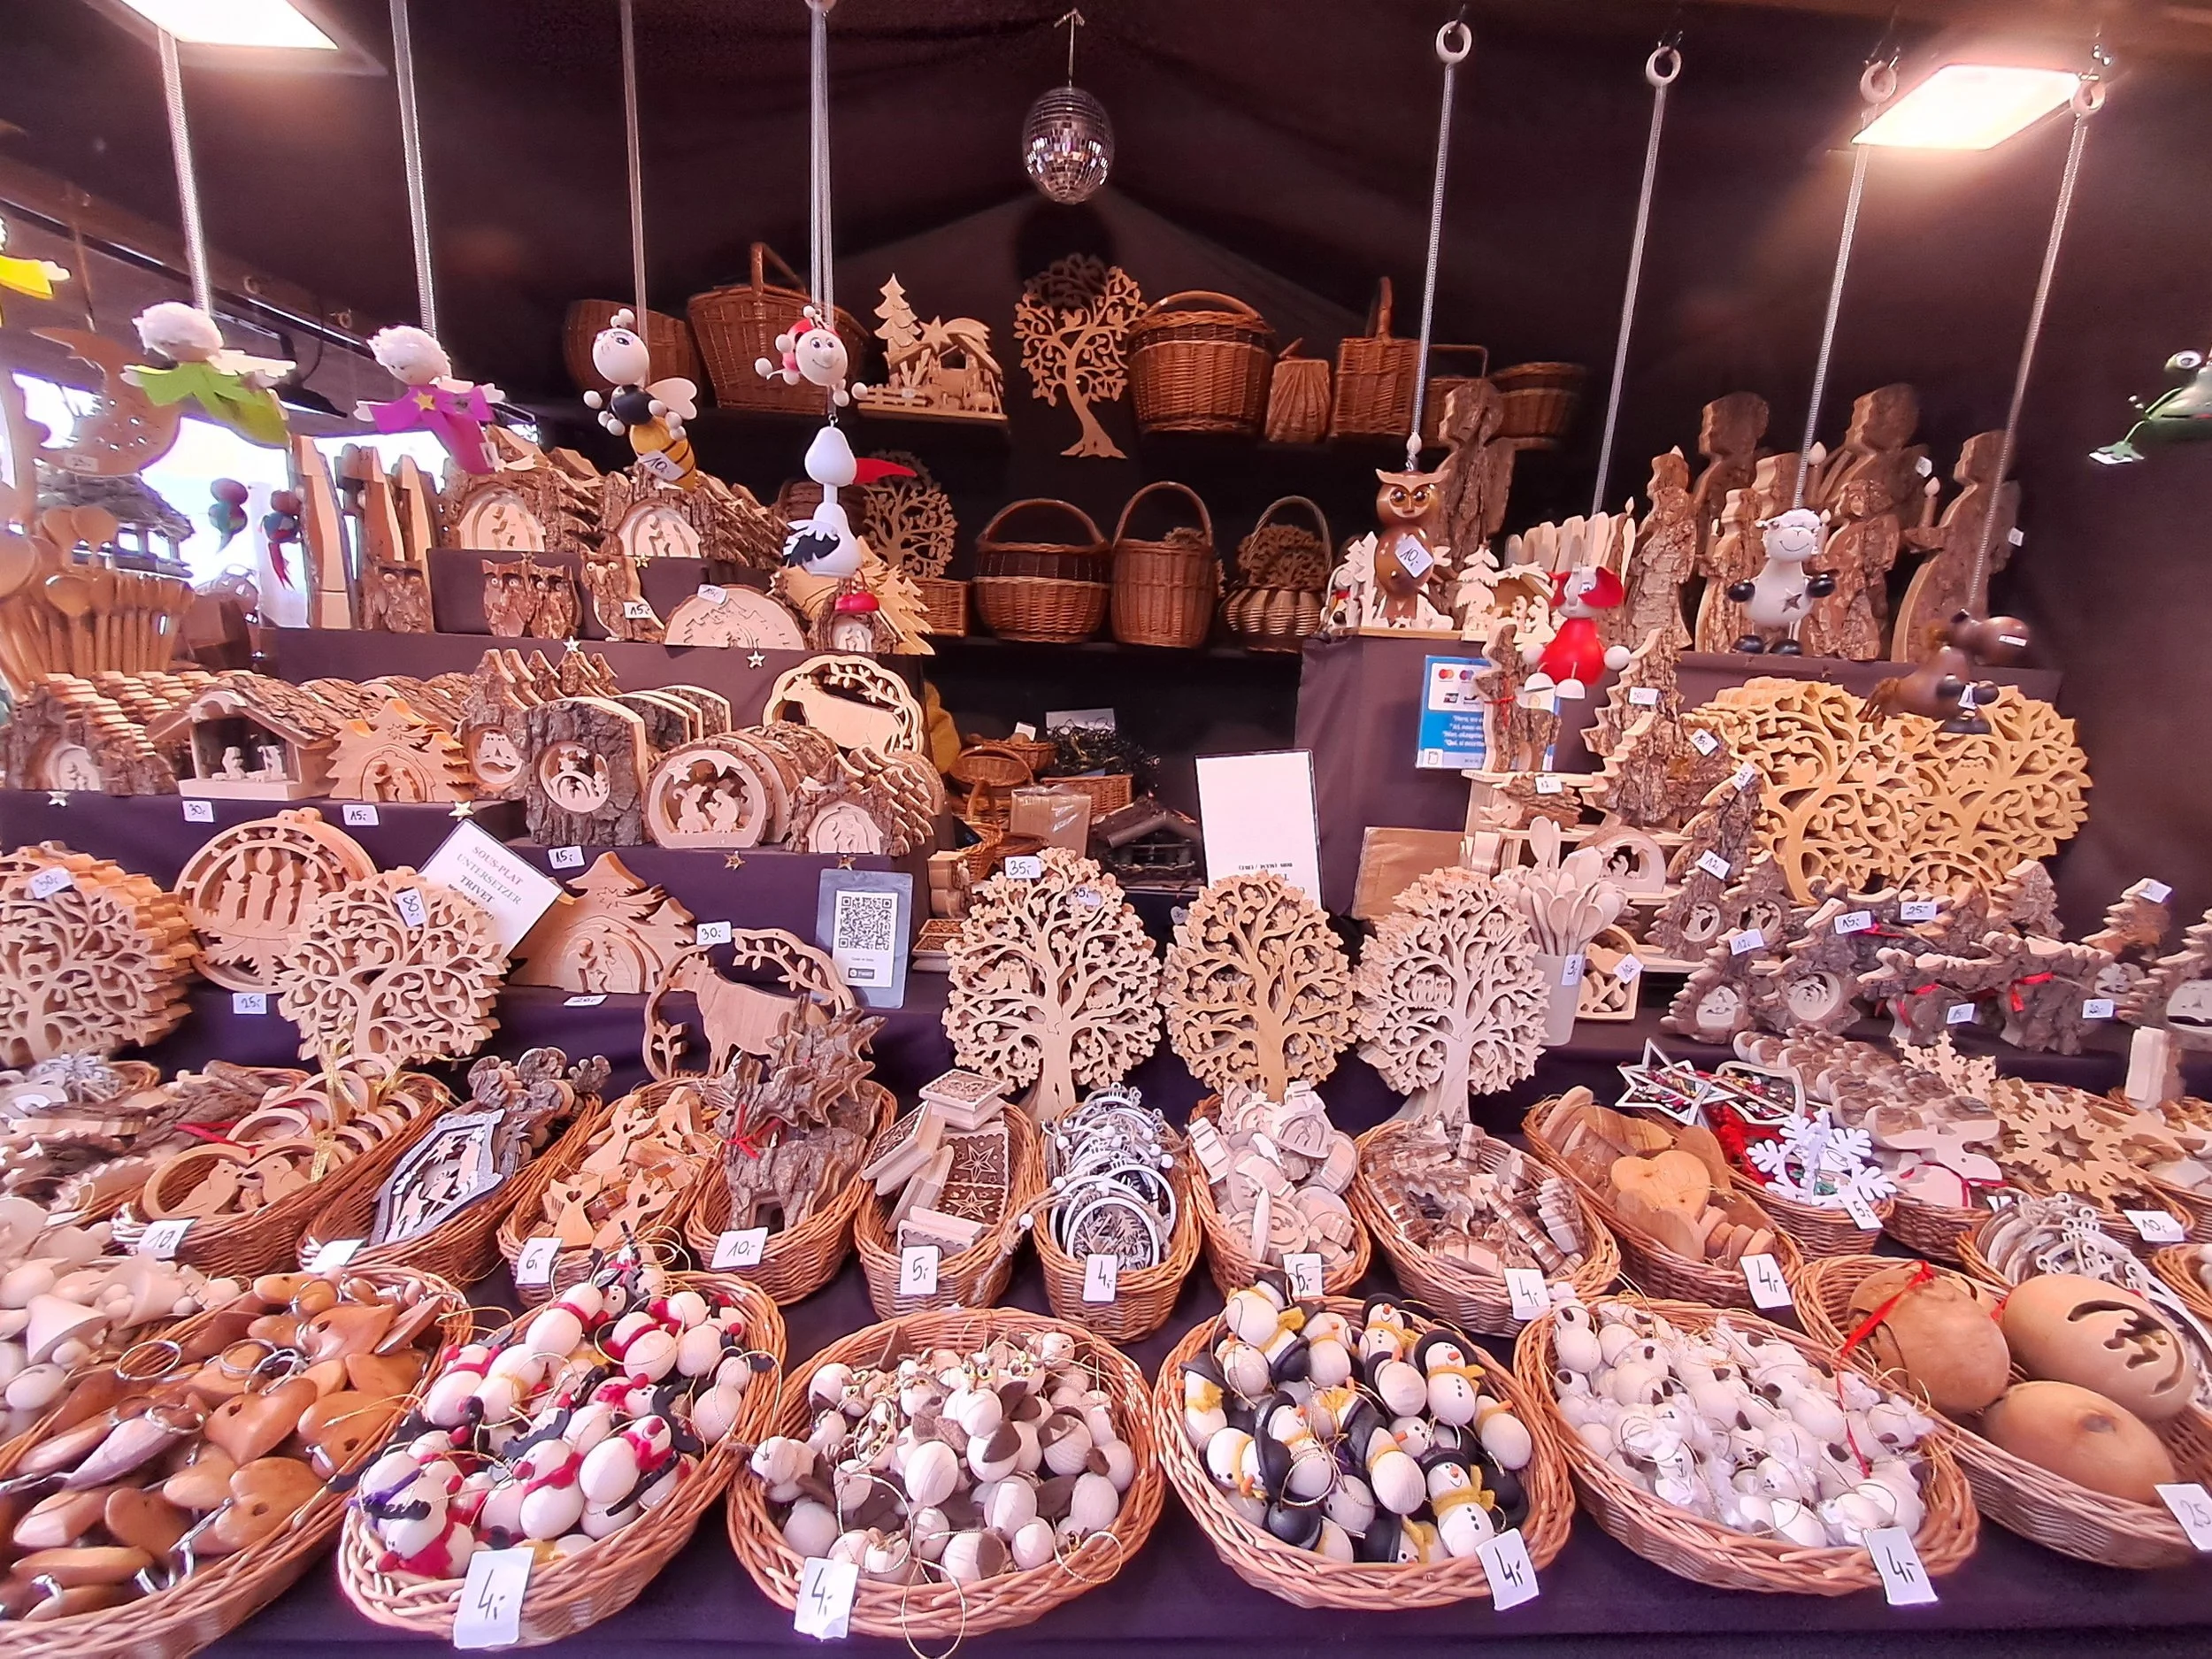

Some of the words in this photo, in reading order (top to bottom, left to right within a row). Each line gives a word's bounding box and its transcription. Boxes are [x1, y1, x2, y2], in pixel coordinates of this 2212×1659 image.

[457, 853, 522, 904] UNTERSETZER
[472, 846, 524, 886] SOUS-PLAT
[460, 874, 495, 902] TRIVET
